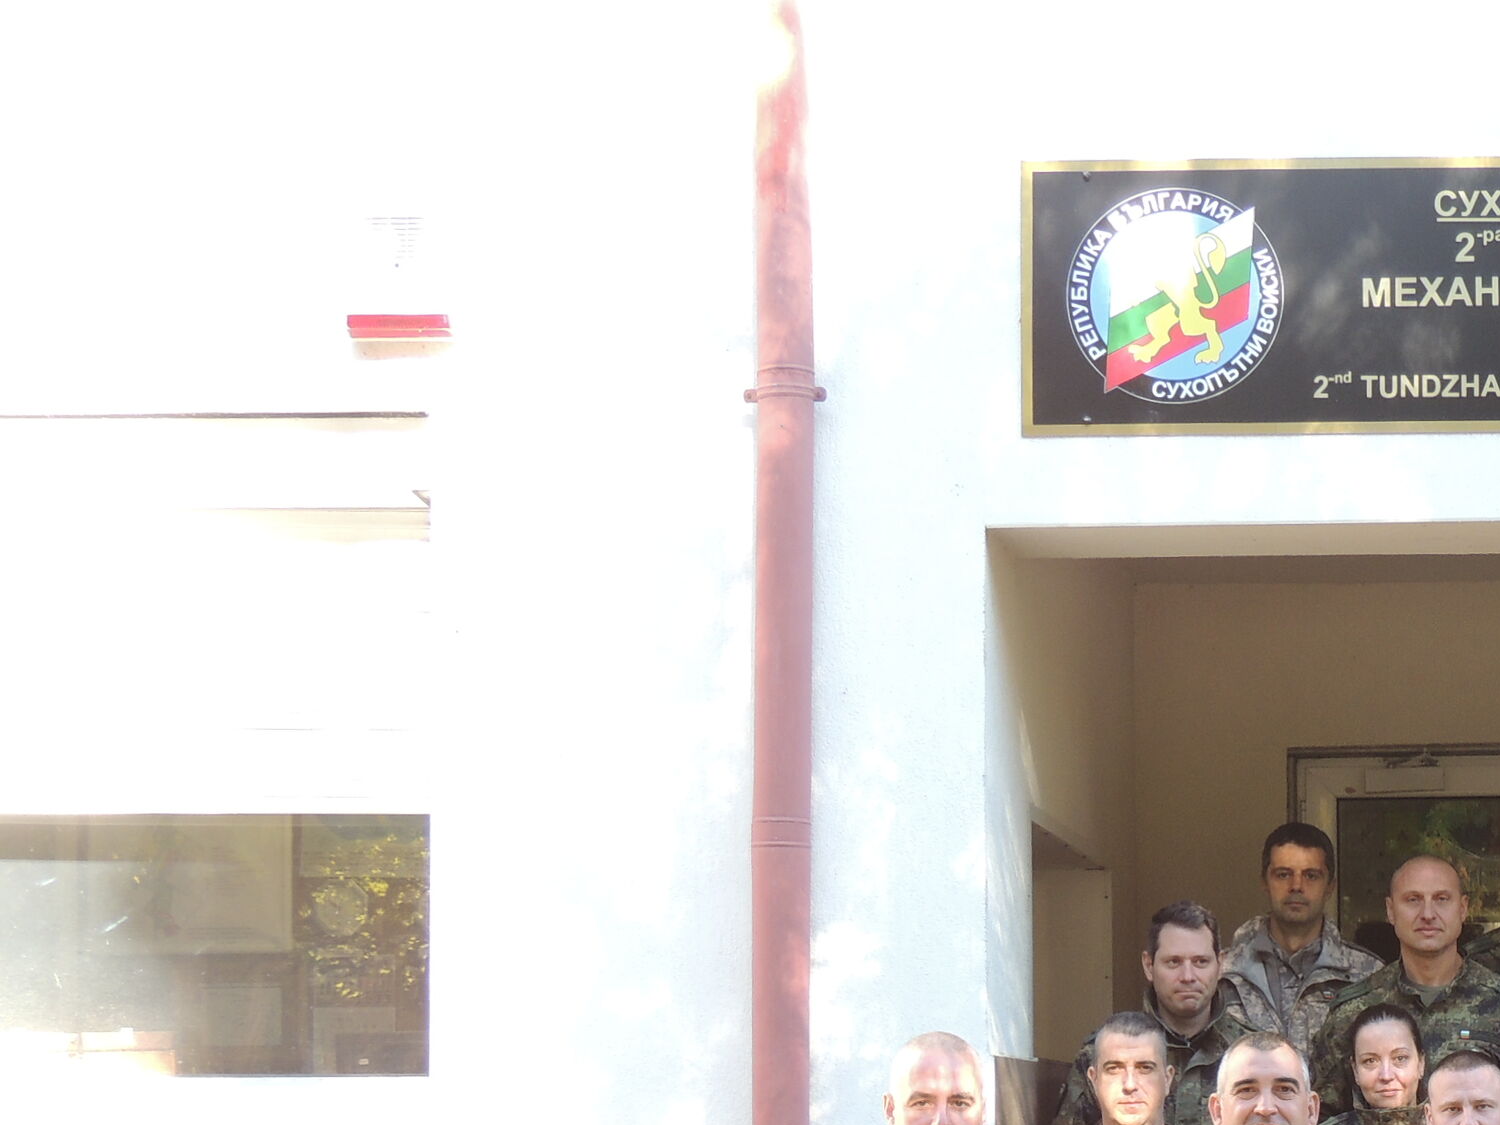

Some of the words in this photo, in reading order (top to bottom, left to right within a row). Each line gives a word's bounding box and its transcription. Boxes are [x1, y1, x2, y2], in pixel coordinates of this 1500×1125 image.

[1071, 229, 1113, 361] РЕПУБЛИКА
[1106, 191, 1235, 229] БЪЛГАРИЯ
[1151, 334, 1268, 399] СУХОПЪТНИ
[1252, 247, 1280, 335] ВОЙСКИ
